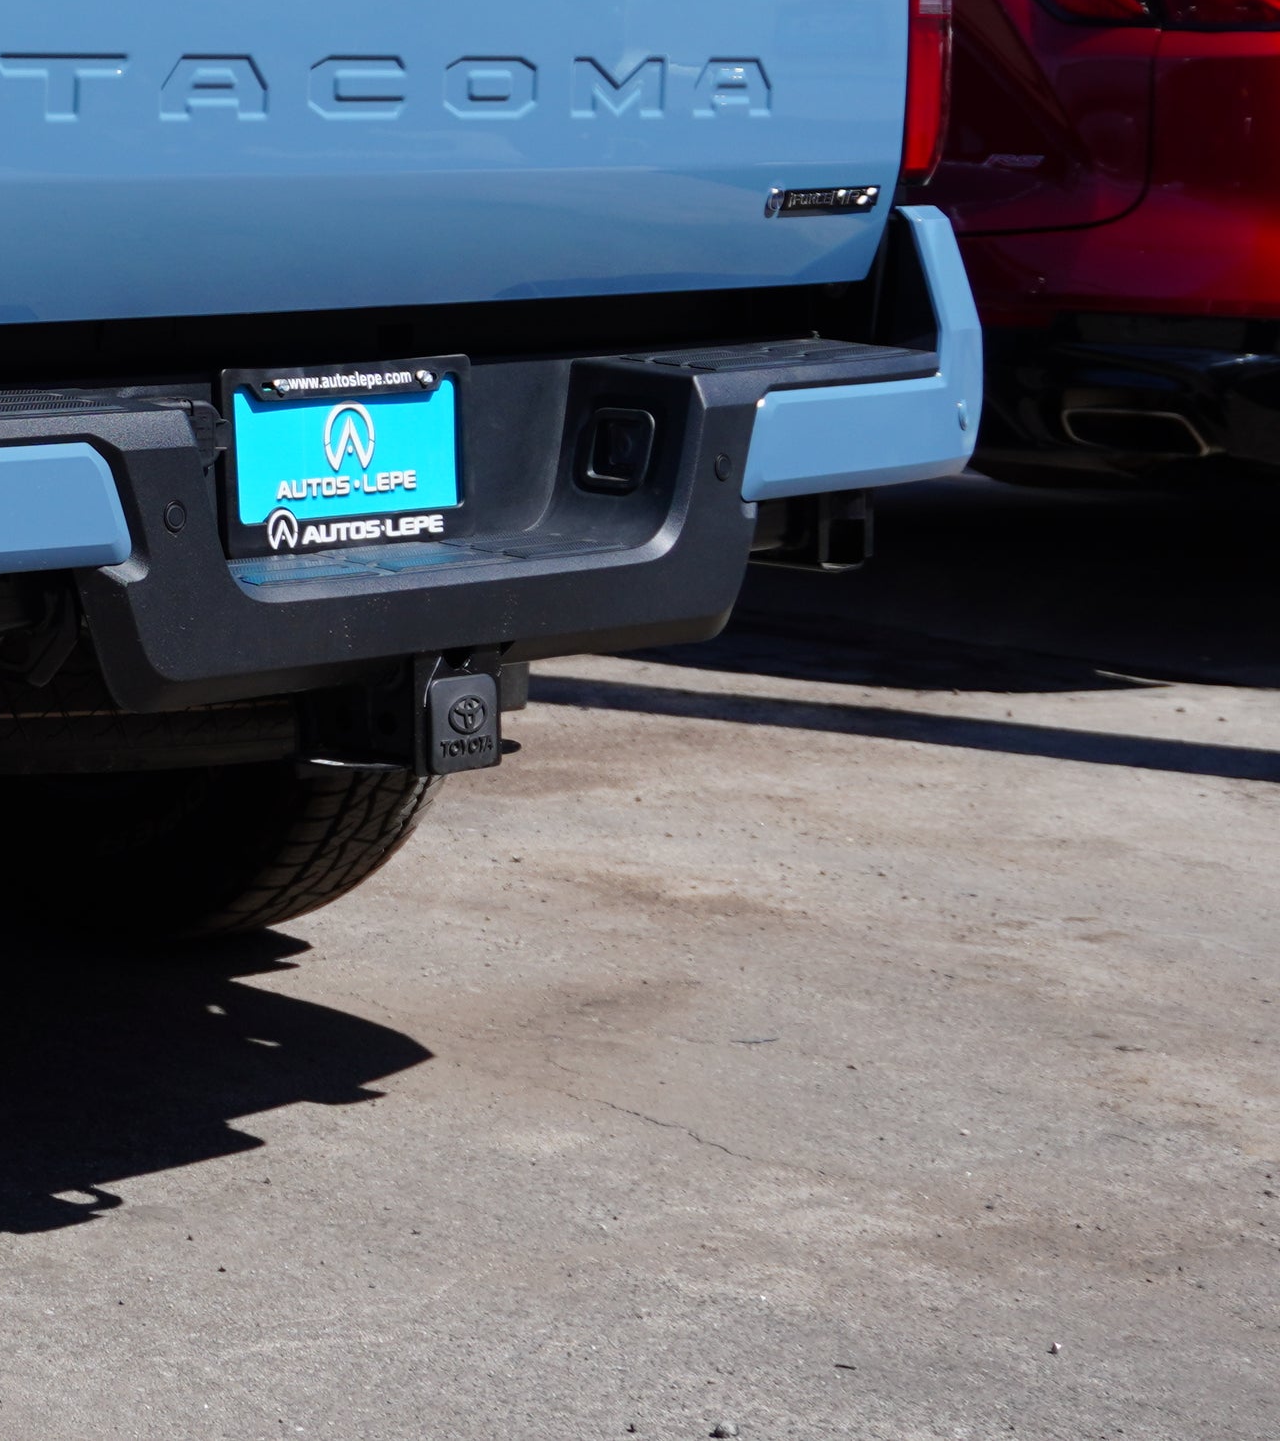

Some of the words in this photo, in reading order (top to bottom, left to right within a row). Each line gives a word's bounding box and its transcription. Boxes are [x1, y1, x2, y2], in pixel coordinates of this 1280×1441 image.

[287, 371, 413, 390] www.autoslepe.com
[276, 475, 351, 500] AUTOS
[363, 469, 417, 493] LEPE
[440, 735, 494, 758] TOYOTA
